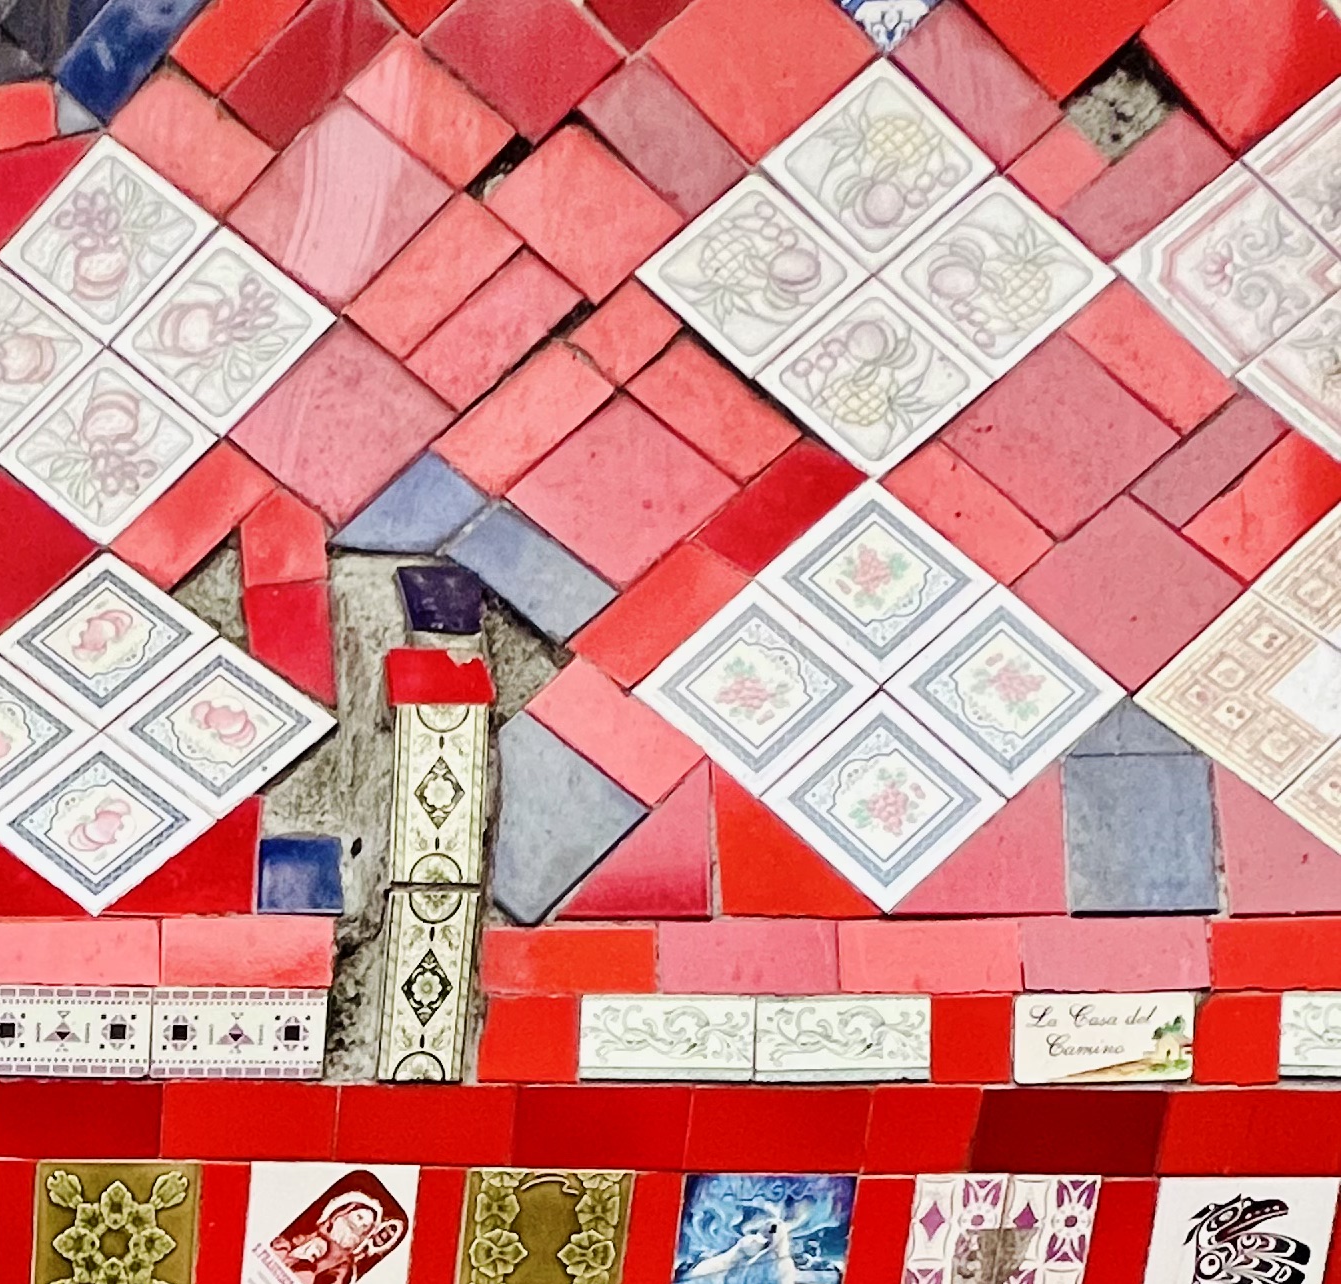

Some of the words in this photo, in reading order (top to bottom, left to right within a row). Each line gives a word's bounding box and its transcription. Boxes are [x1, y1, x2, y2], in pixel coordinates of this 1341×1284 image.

[1026, 1004, 1058, 1028] La
[1068, 1003, 1118, 1028] Casa
[1124, 1005, 1158, 1026] del
[1045, 1032, 1126, 1058] Camino
